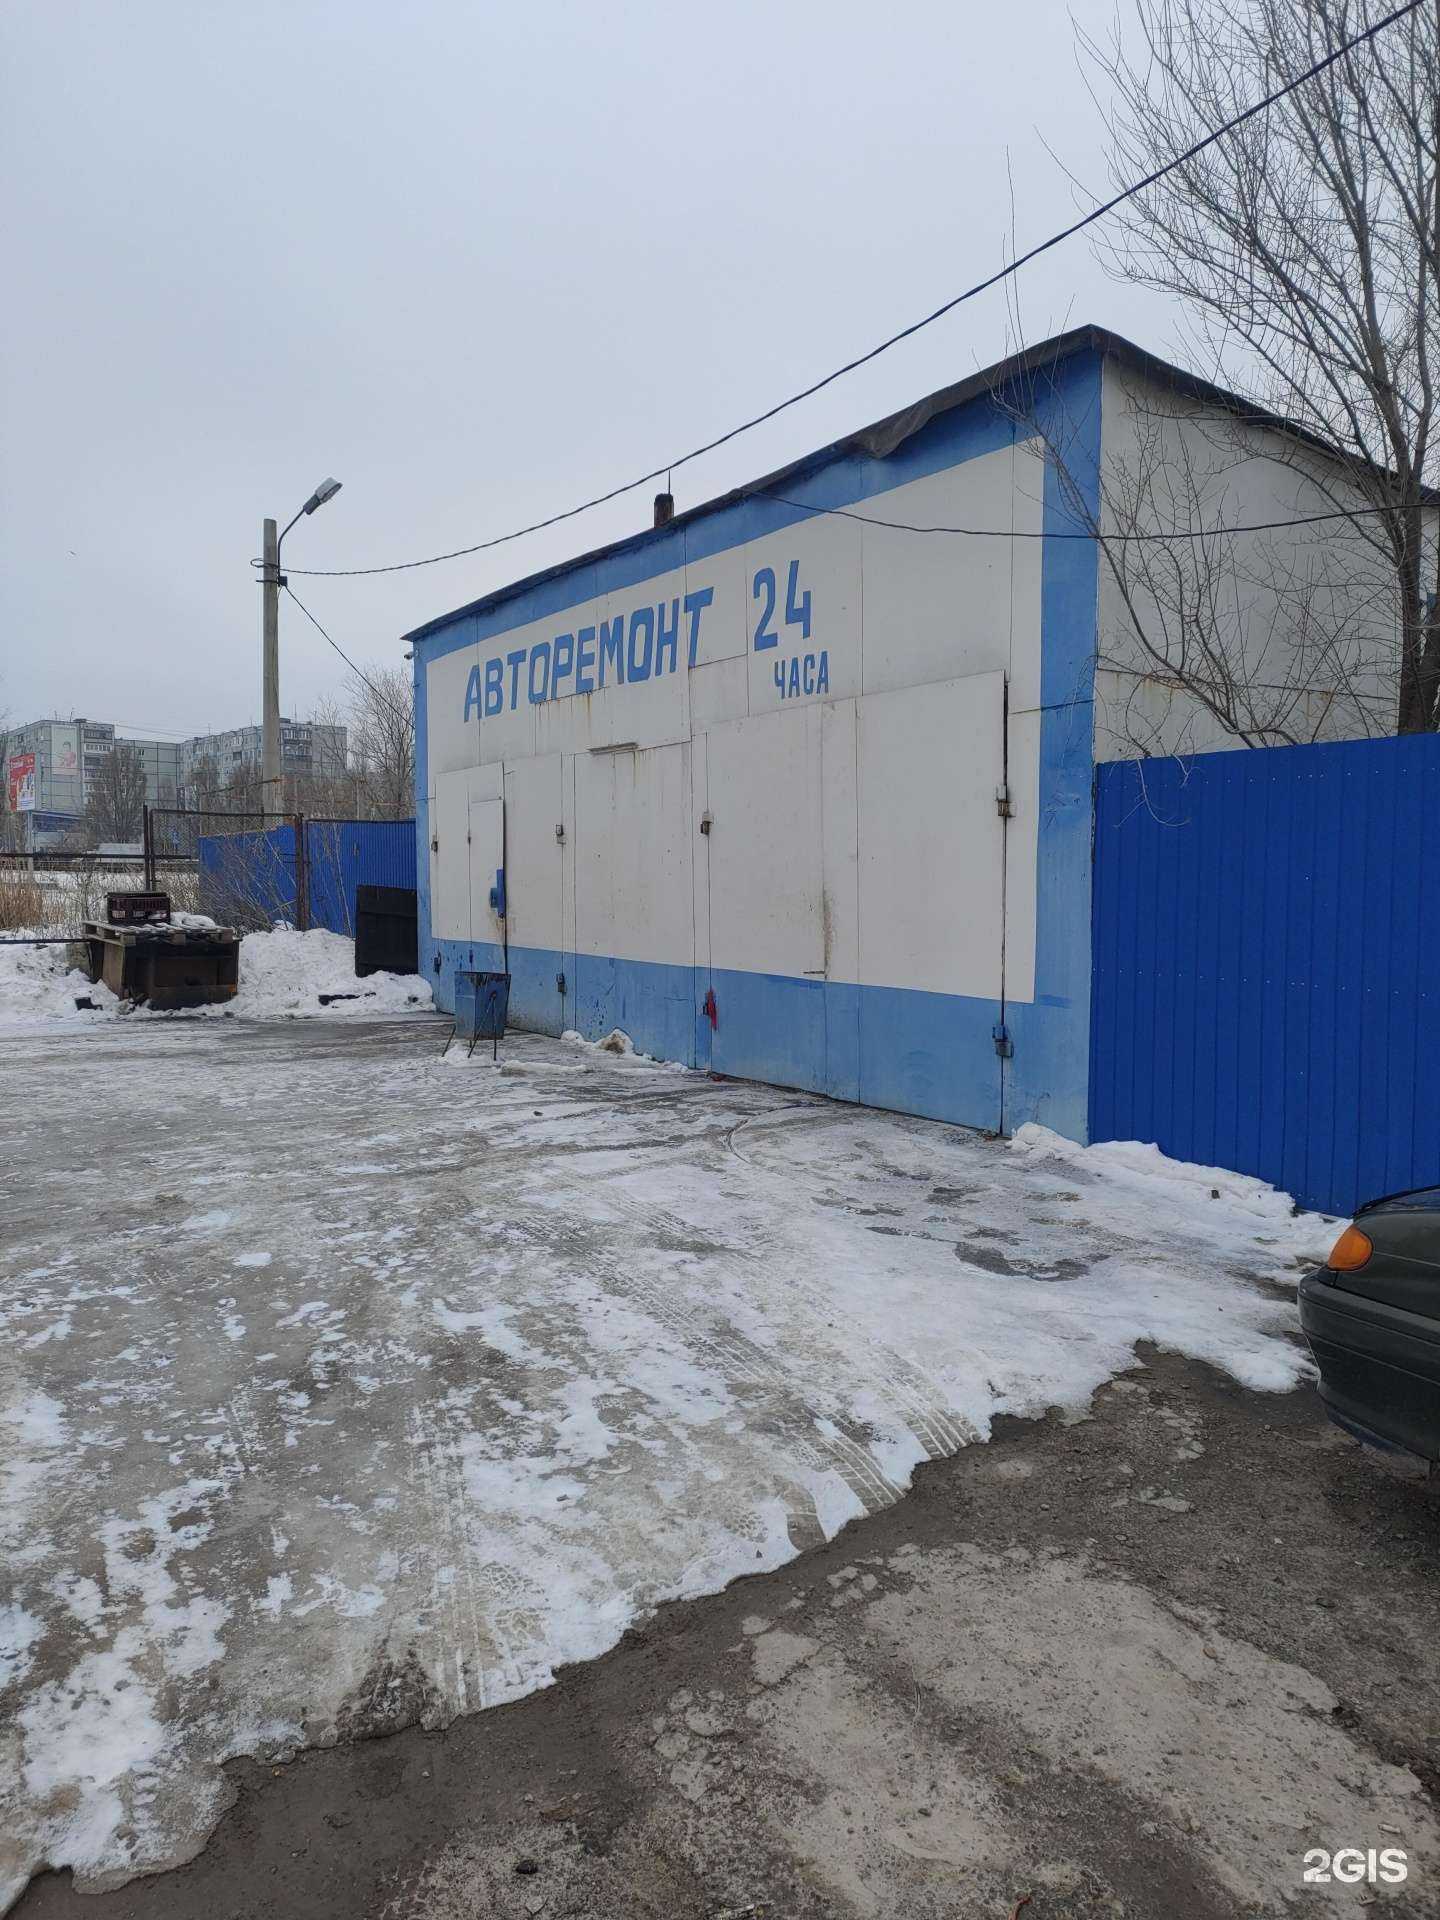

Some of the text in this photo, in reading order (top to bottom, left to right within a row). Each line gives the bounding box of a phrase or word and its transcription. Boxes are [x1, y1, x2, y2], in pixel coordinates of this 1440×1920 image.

[464, 560, 811, 722] АВТОРЕМОНТ 24
[774, 651, 829, 699] ЧАСА
